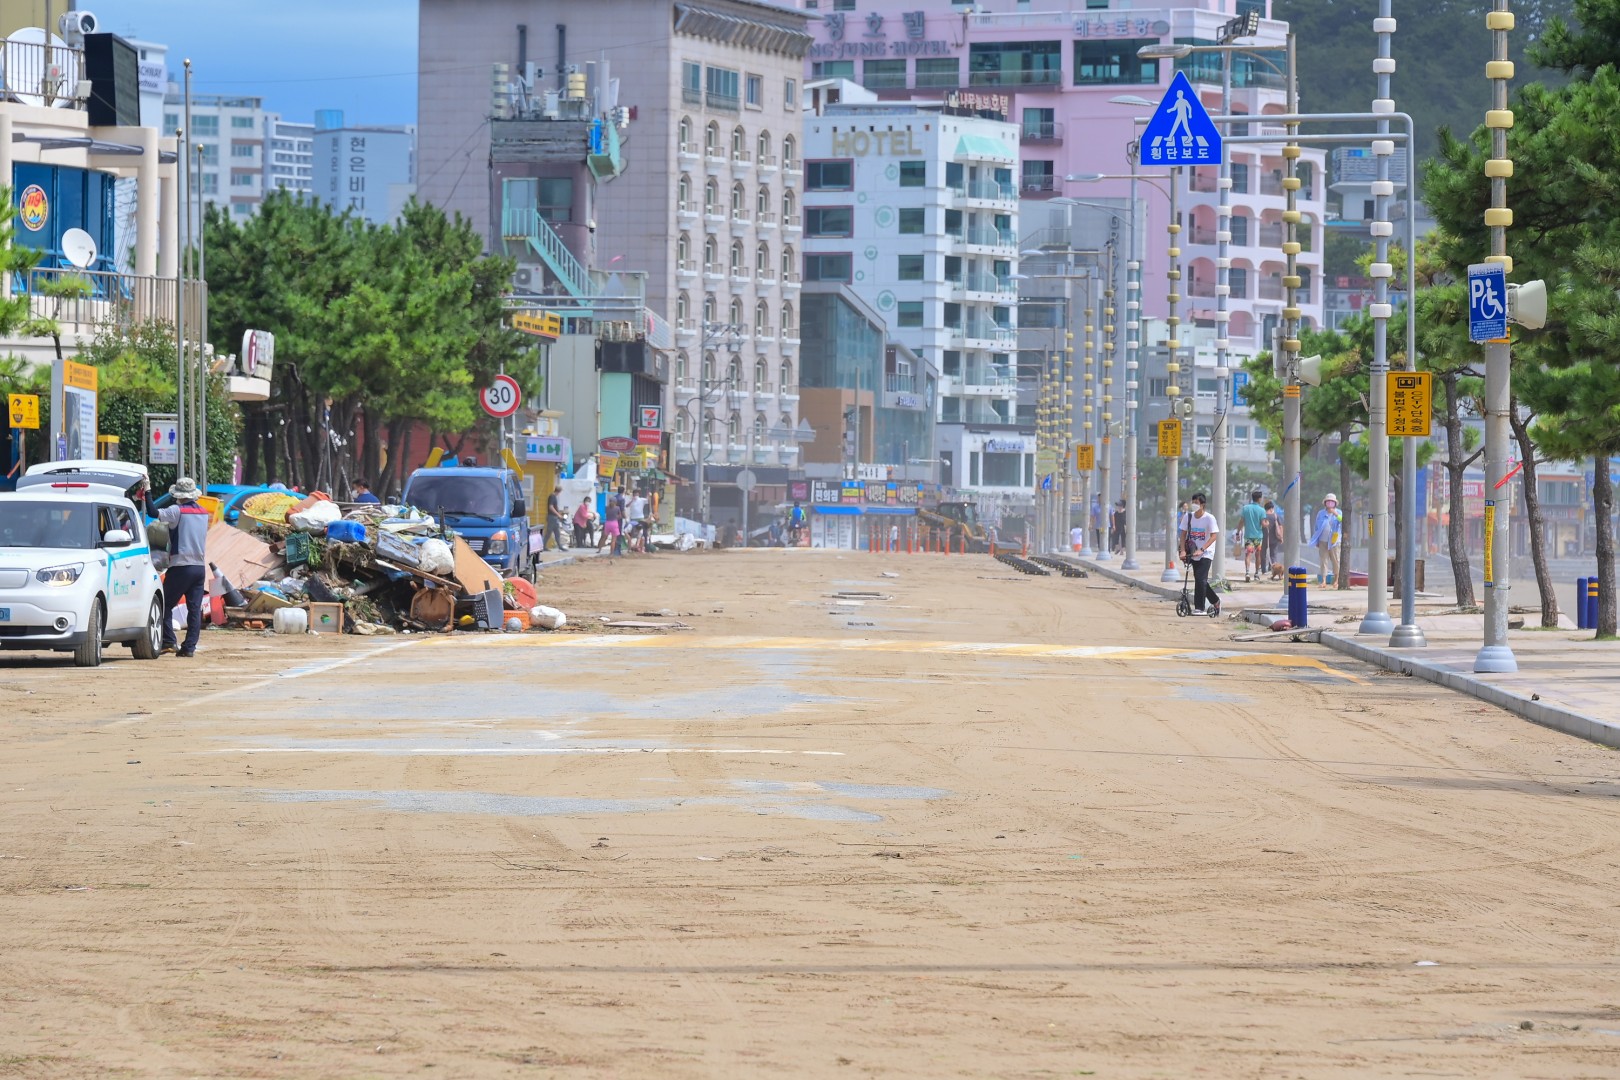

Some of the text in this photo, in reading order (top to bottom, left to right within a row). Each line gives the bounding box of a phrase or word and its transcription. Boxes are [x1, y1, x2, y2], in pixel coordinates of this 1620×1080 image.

[1073, 18, 1149, 38] 레스토랑
[832, 130, 922, 157] HOTEL
[1150, 147, 1210, 160] 횡단보도
[27, 190, 43, 208] 119
[1471, 279, 1485, 309] P
[489, 386, 511, 405] 30
